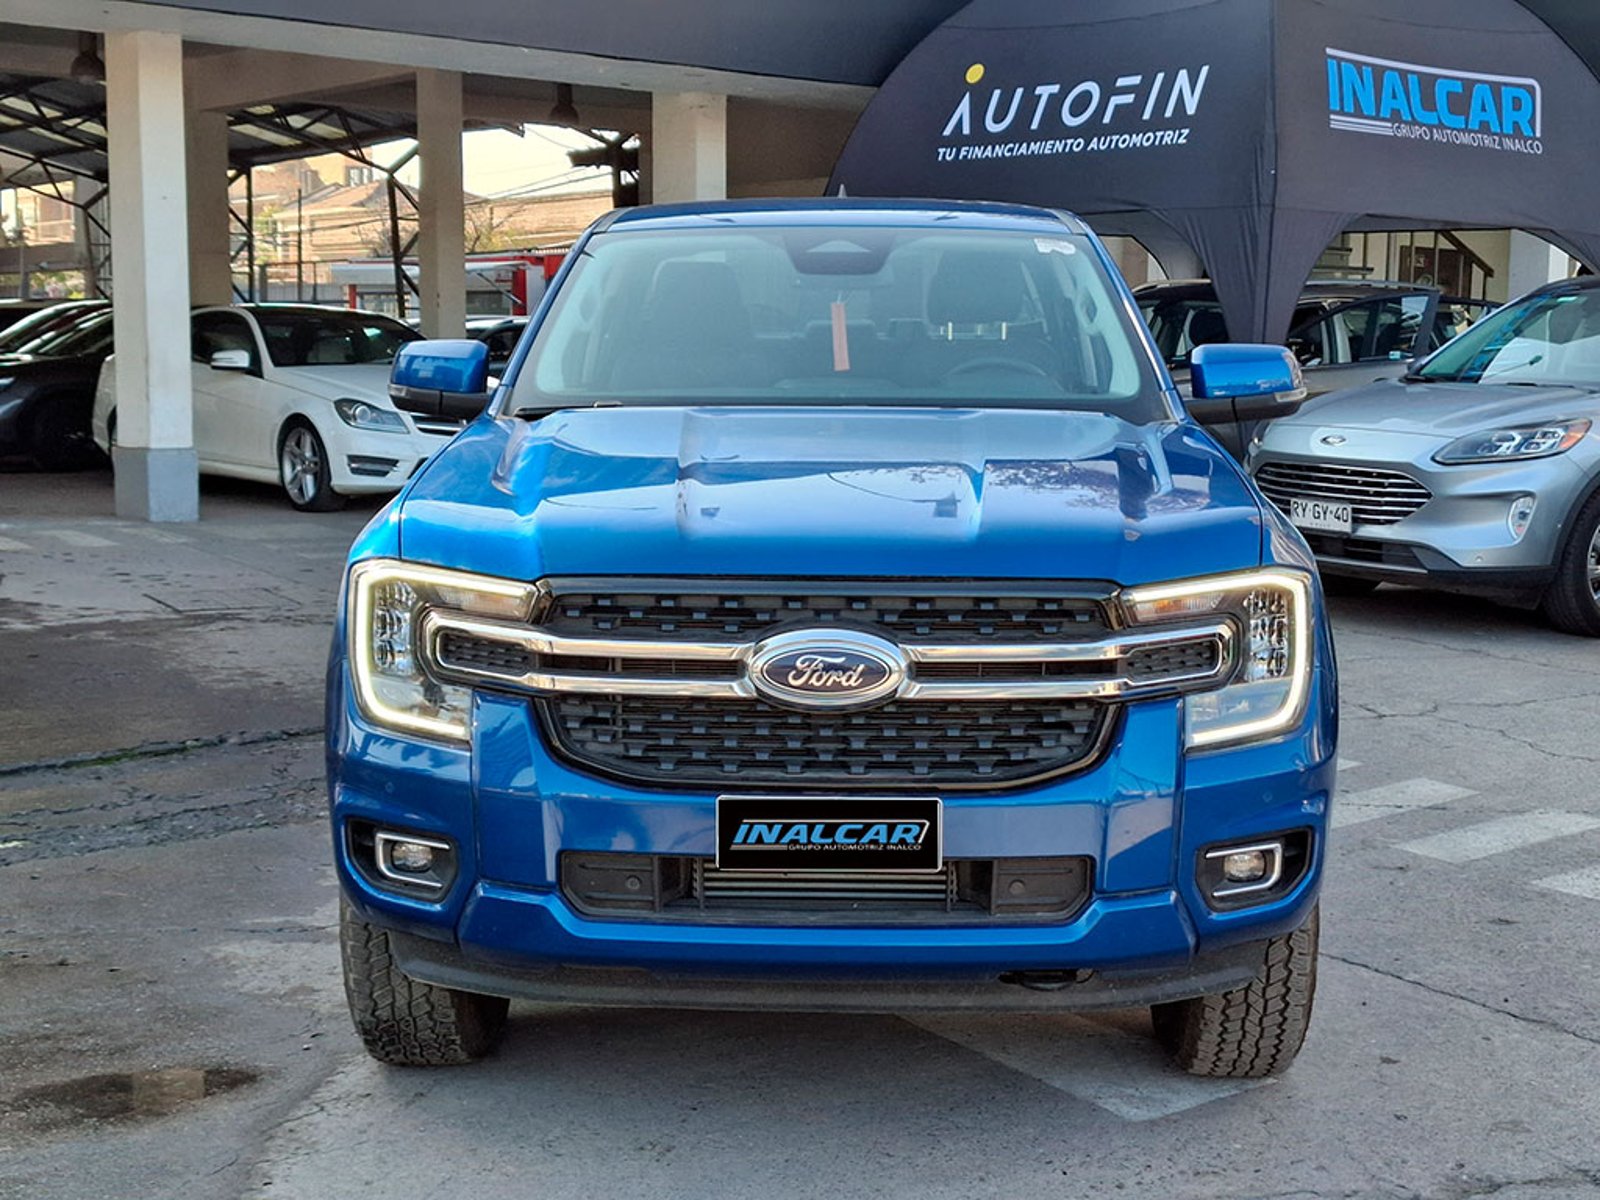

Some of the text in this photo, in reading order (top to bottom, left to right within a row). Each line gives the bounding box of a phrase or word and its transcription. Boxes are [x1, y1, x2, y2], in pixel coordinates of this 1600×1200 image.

[942, 64, 1210, 137] AUTOFIN
[1326, 58, 1535, 138] INALCAR
[937, 128, 1191, 162] TU FINANCIAMIENTO AUTOMOTRIZ
[1392, 122, 1543, 154] GRUPO AUTOMOTRIZ INALCO
[787, 654, 866, 687] Ford
[732, 823, 921, 844] INALCAR
[788, 843, 922, 851] GRUPO AUTOMOTRIZ INALCO
